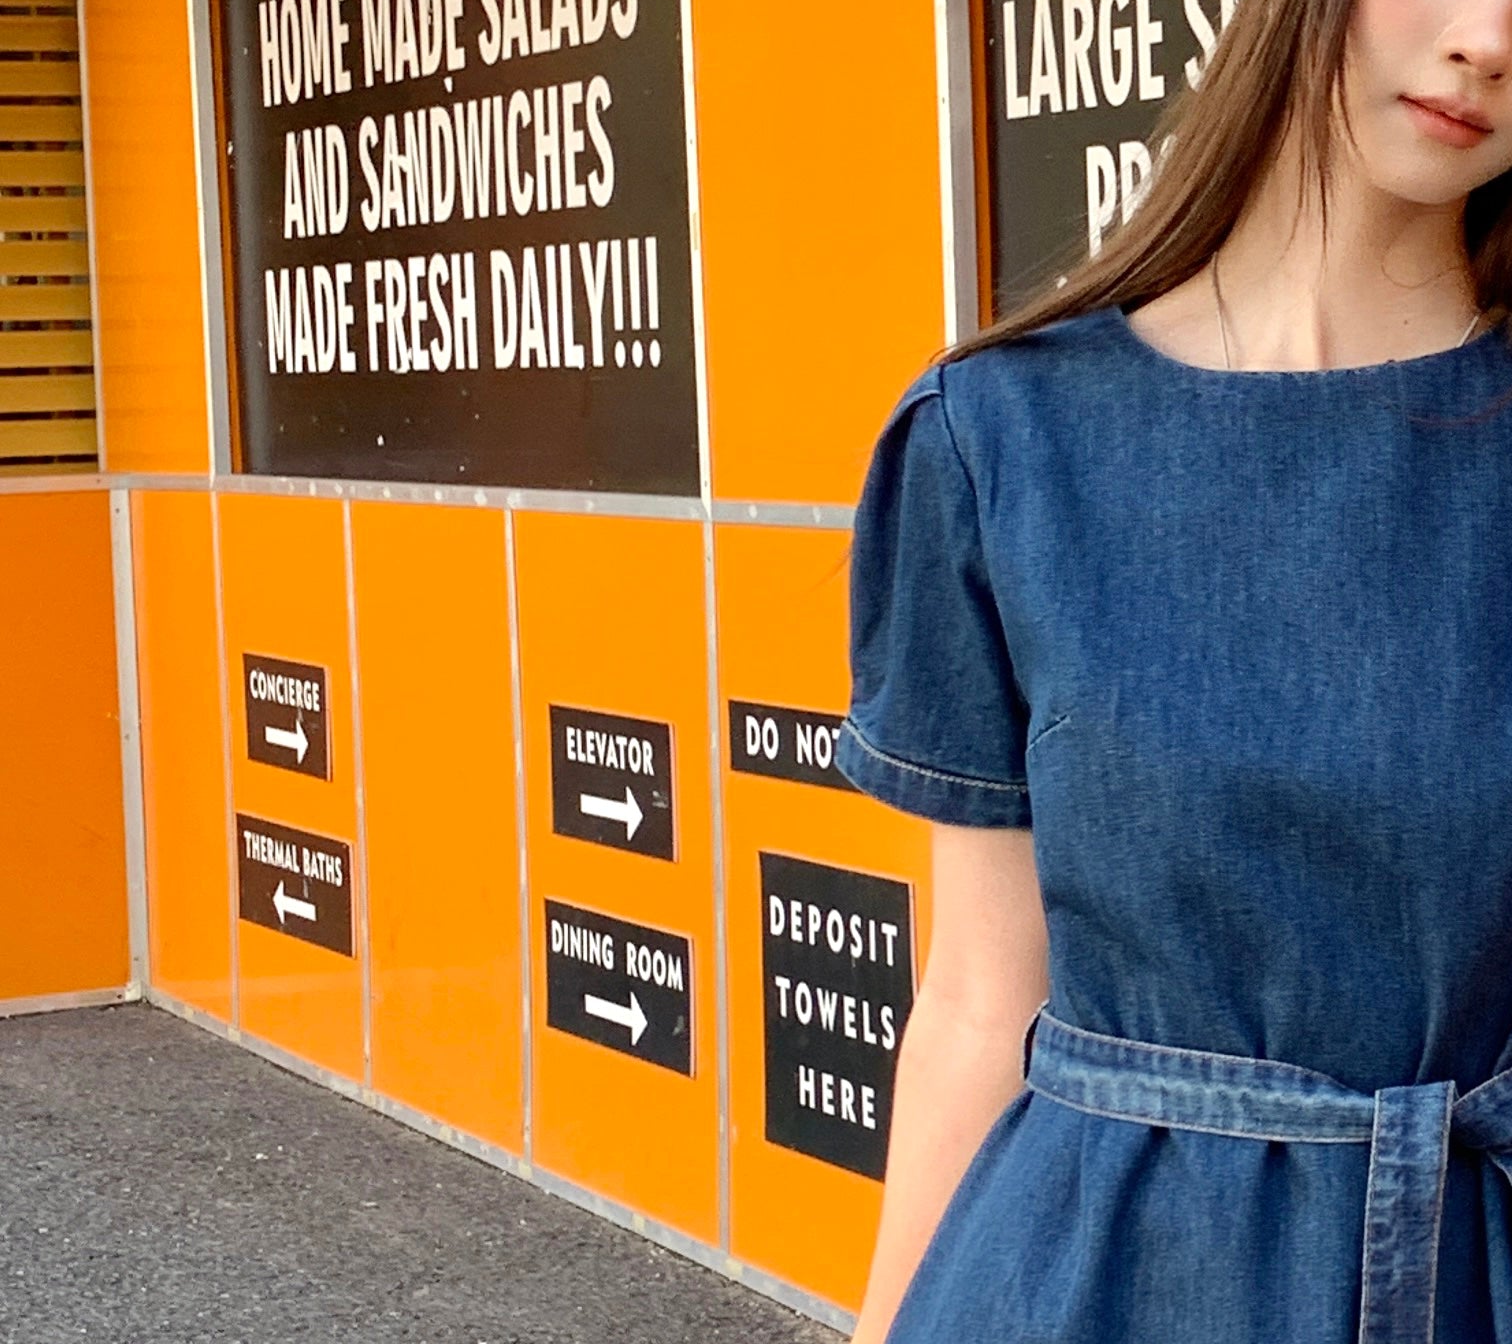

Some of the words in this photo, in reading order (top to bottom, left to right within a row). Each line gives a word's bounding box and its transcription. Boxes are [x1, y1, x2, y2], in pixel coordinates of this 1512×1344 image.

[283, 125, 349, 238] AND
[360, 75, 614, 232] SANDWICHES
[264, 263, 356, 374] MADE
[365, 252, 479, 374] FRESH
[490, 236, 661, 370] DAILY!!!
[250, 669, 320, 712] CONCIERGE
[566, 726, 655, 776] ELEVATOR
[745, 715, 779, 760] DO
[796, 722, 841, 770] NO
[244, 830, 300, 874] THERMAL
[302, 847, 342, 887] BATHS
[551, 919, 614, 970] DINING
[626, 940, 684, 991] ROOM
[769, 895, 898, 967] DEPOSIT
[775, 975, 896, 1051] TOWELS
[799, 1065, 876, 1130] HERE
